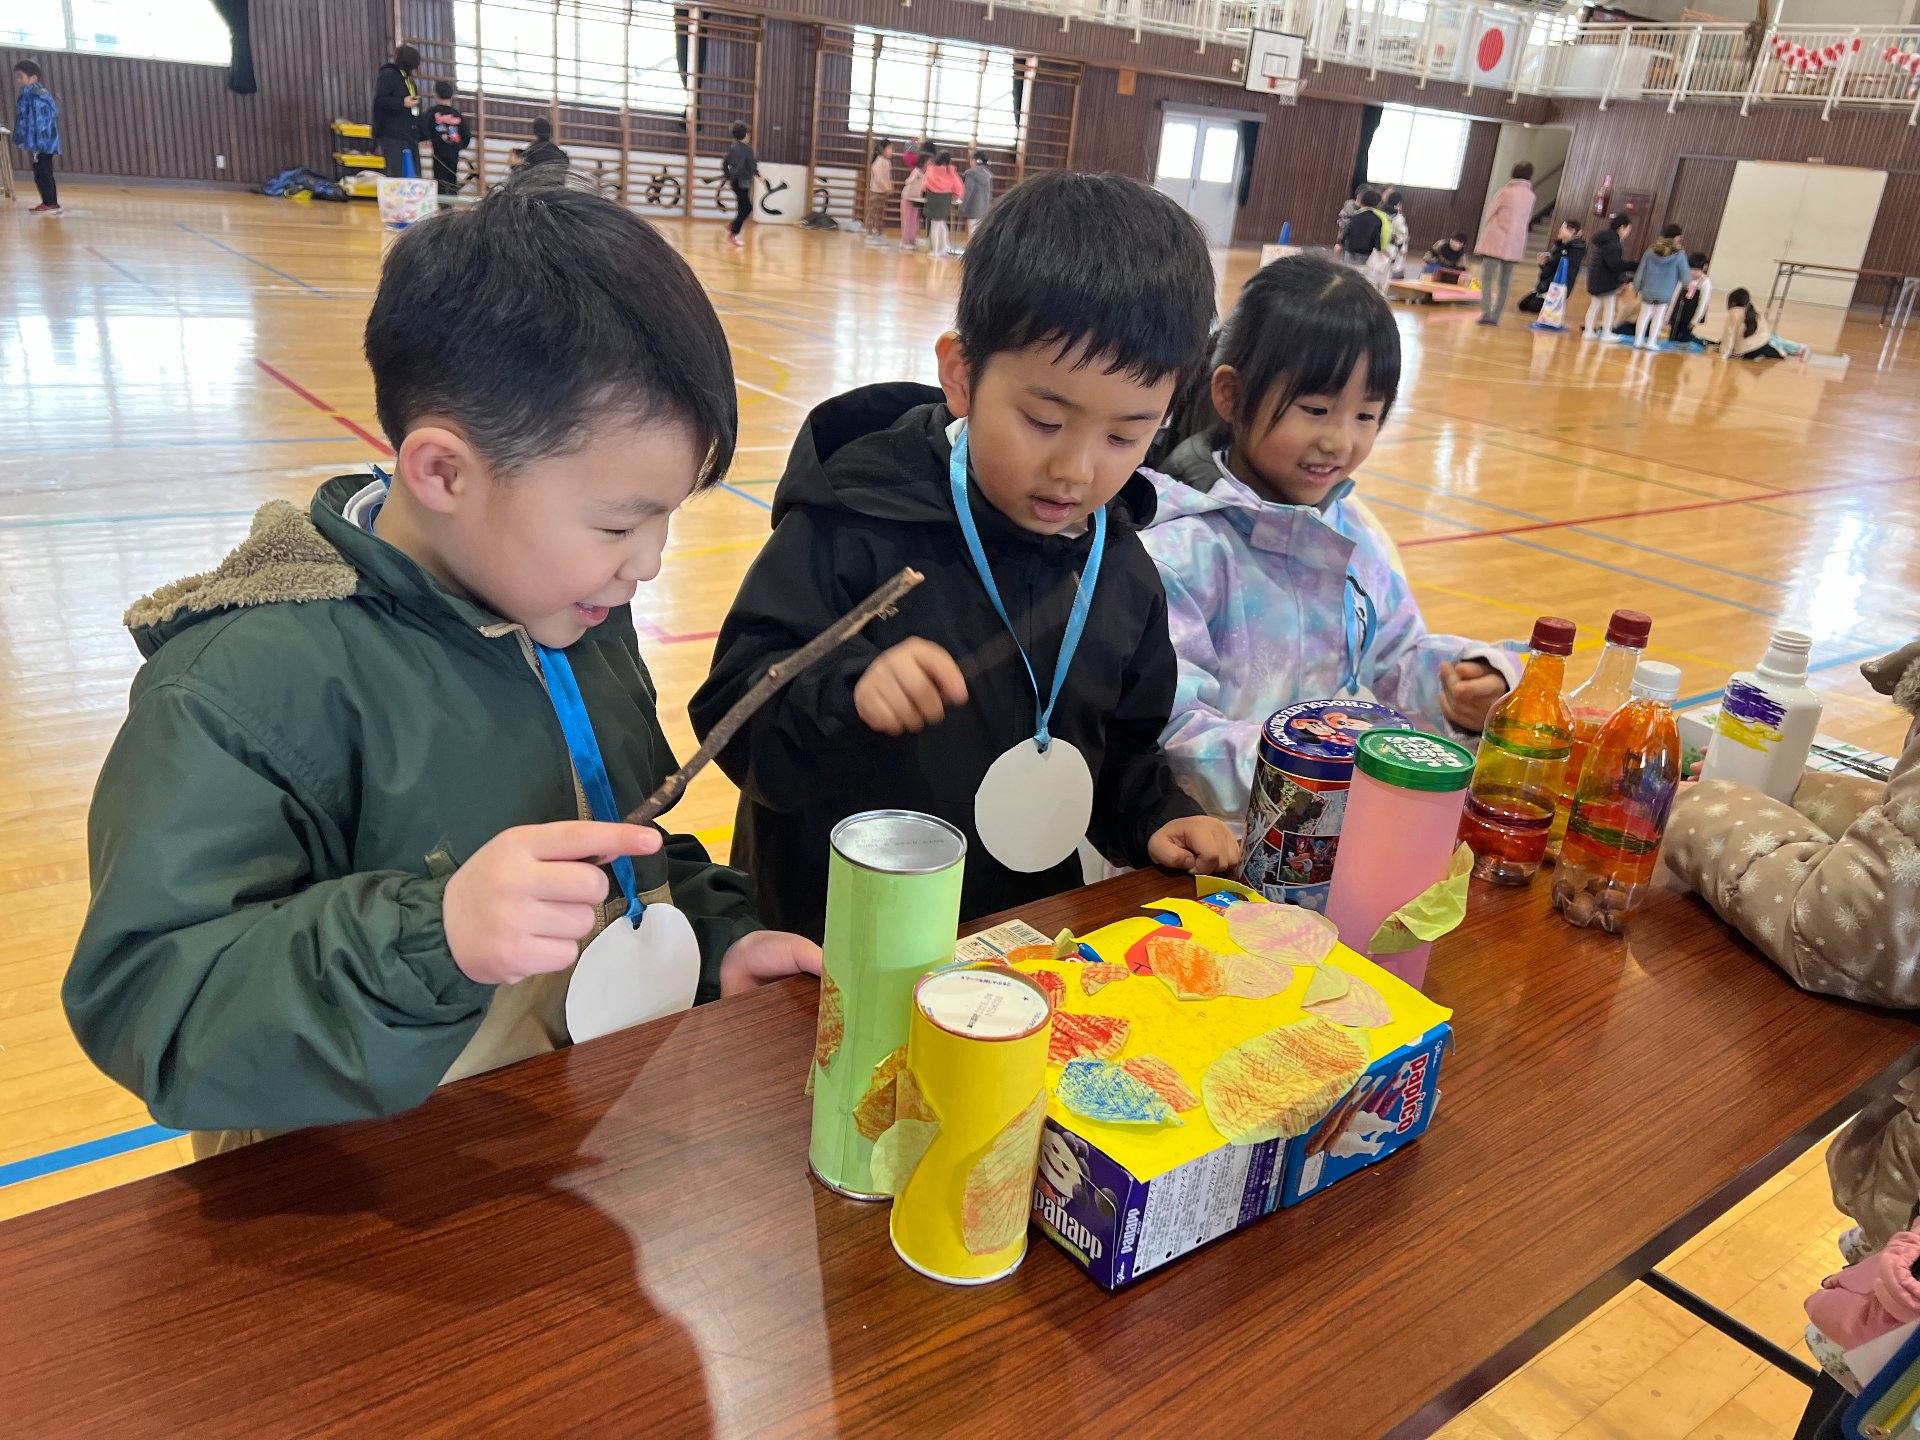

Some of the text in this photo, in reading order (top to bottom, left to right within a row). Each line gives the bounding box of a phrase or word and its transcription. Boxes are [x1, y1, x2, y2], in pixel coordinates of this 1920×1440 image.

[1269, 714, 1297, 746] CRUNCH
[1280, 700, 1373, 716] CHOCOLATE
[1396, 1052, 1430, 1134] papico
[1033, 1188, 1103, 1260] panapp
[1121, 1208, 1140, 1254] panapp
